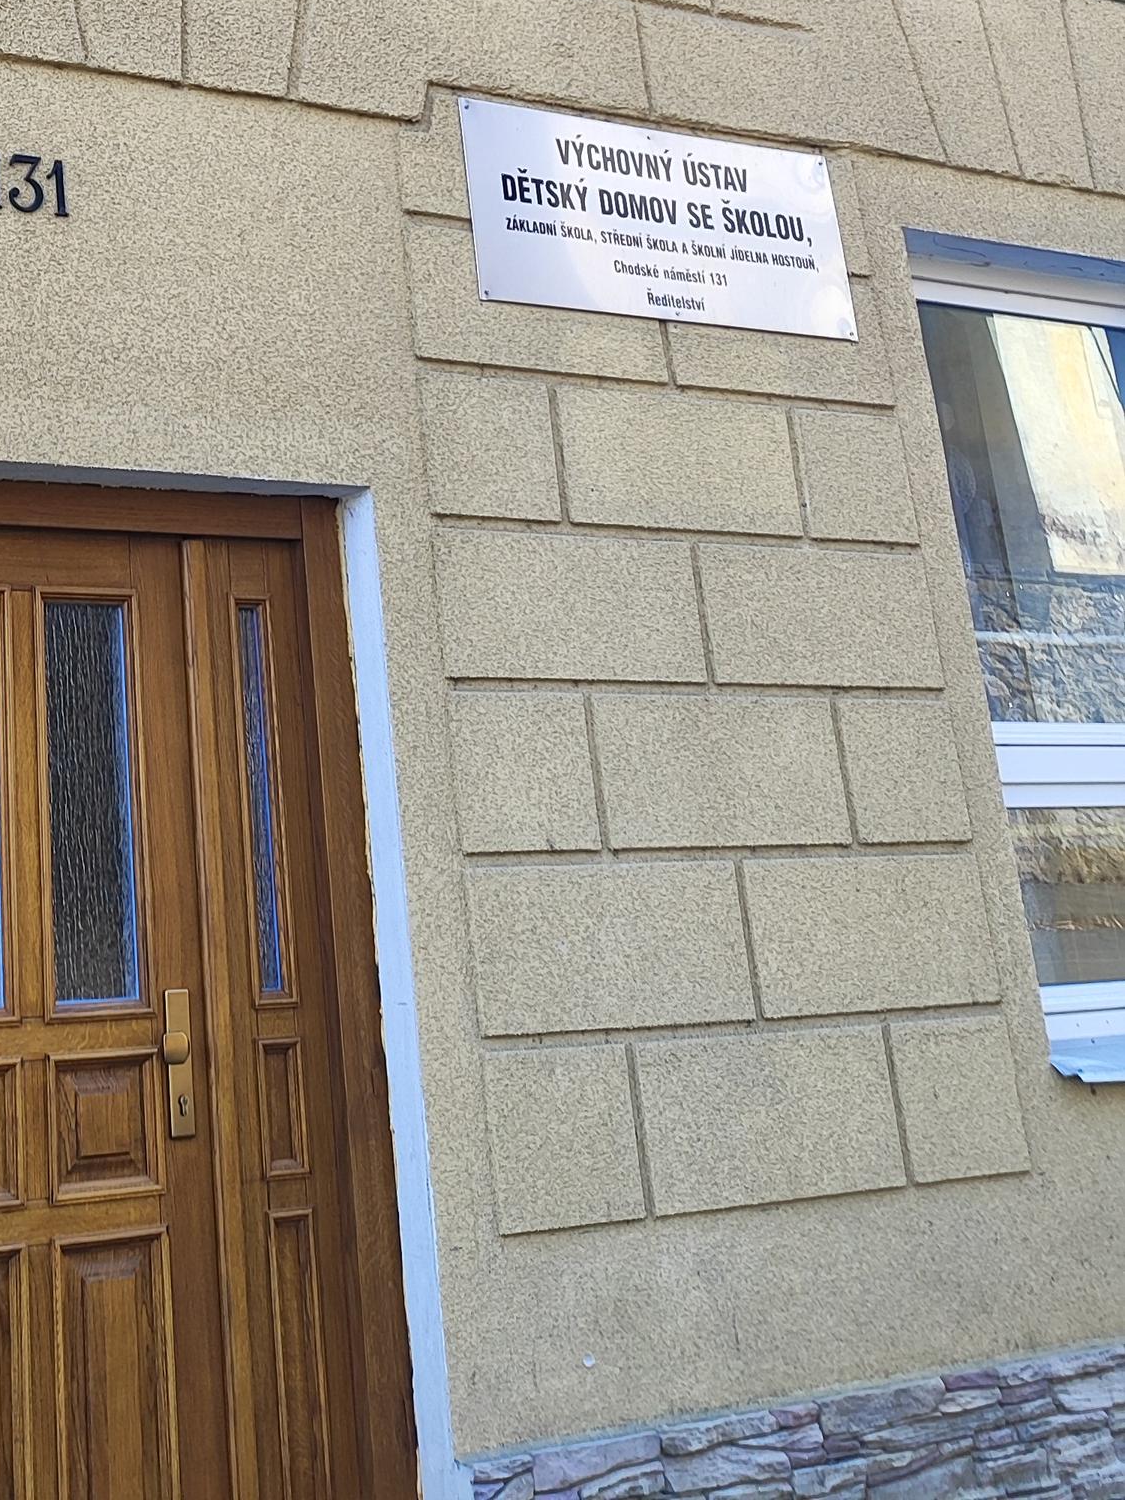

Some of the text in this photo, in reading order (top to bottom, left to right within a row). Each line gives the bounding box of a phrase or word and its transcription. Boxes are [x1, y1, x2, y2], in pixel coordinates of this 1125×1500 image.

[555, 134, 747, 193] VÝCHOVNÝ ÚSTAV
[501, 167, 813, 247] DĚTSKÝ DOMOV SE ŠKOLOU,
[505, 214, 557, 237] ZÁKLADNÍ
[560, 221, 598, 244] ŠKOLA,
[601, 228, 643, 249] STŘEDNÍ
[646, 234, 679, 254] ŠKOLA
[682, 242, 689, 255] A
[691, 240, 727, 260] ŠKOLNÍ
[730, 245, 770, 266] JÍDELNA
[614, 259, 728, 287] Chodské náměstí 131
[647, 287, 706, 312] Ředitelství
